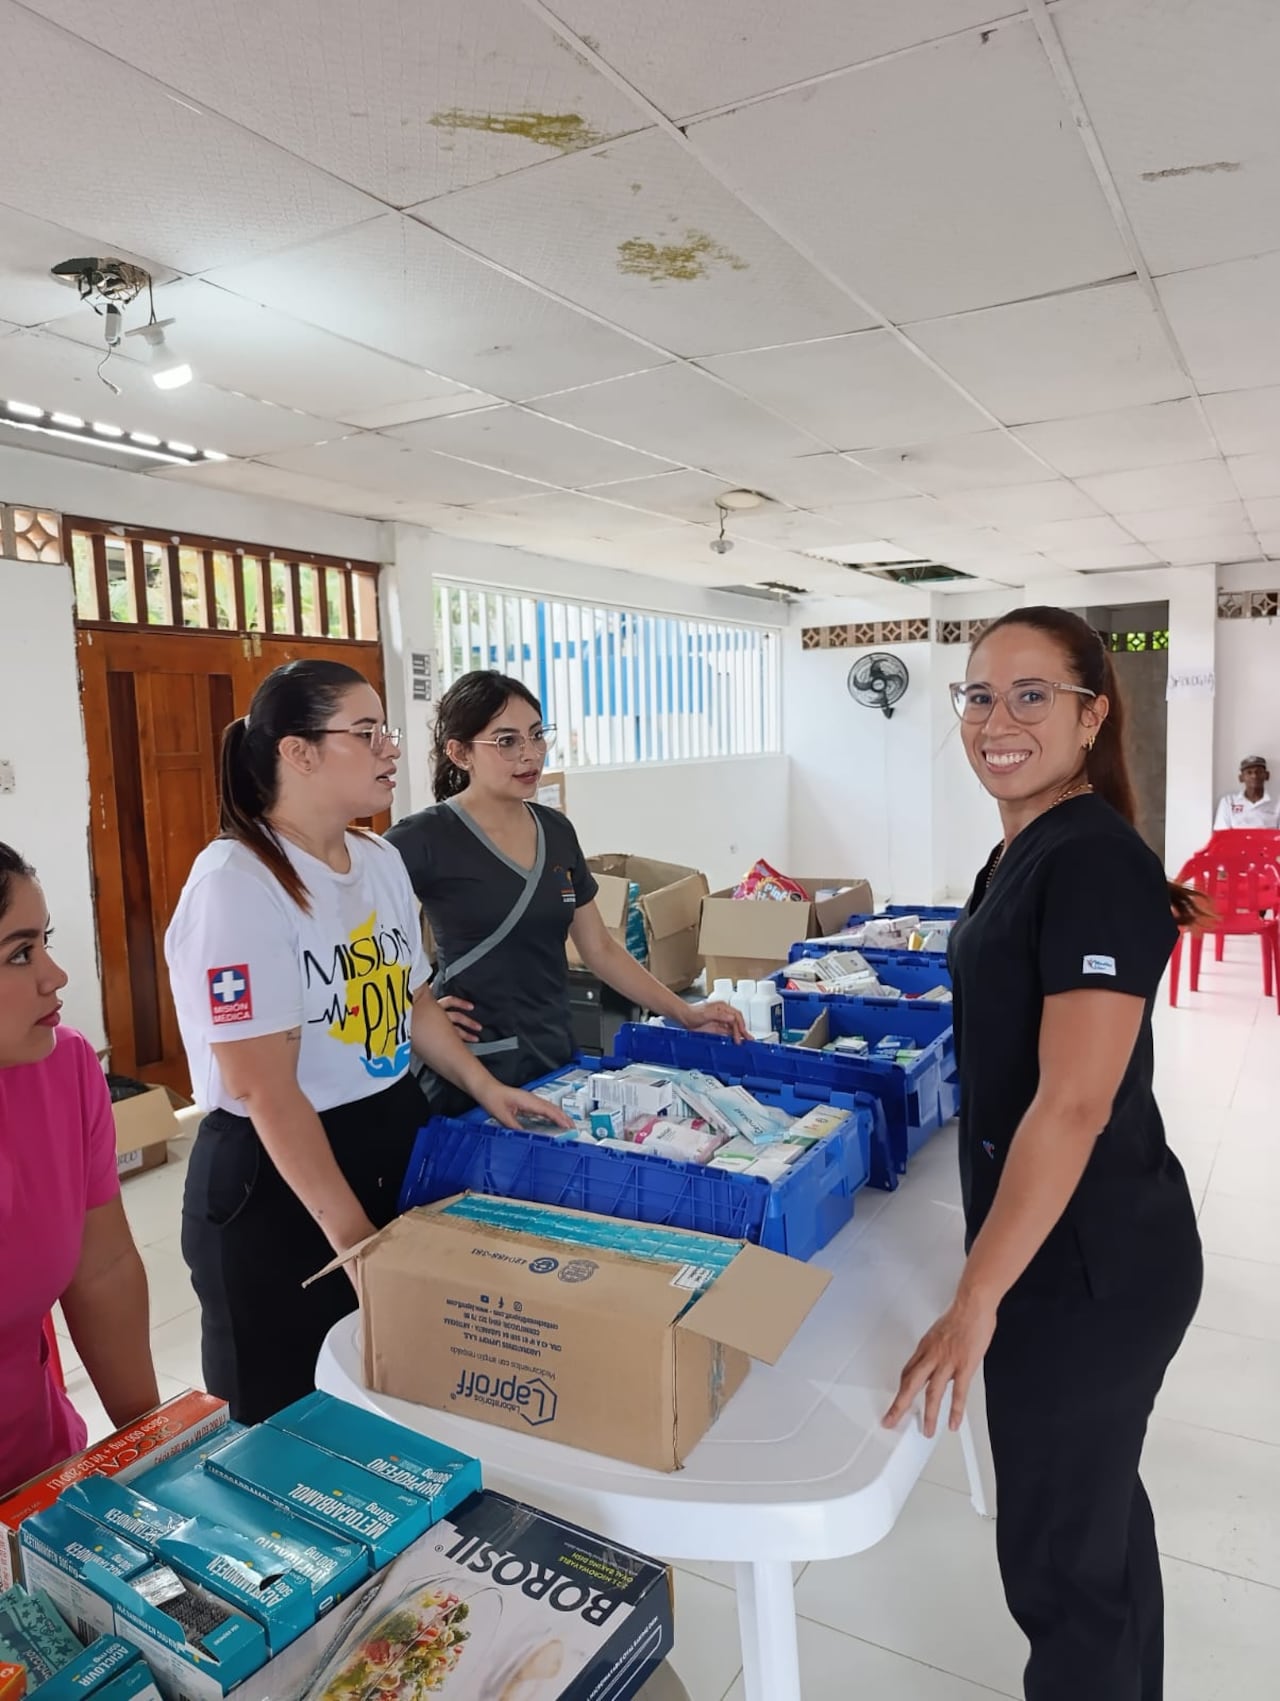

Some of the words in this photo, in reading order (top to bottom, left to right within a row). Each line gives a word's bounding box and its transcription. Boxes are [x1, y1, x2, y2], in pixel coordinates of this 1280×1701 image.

[497, 1357, 509, 1366] con
[455, 1370, 543, 1416] Laproff
[473, 1394, 520, 1413] Laboratorios
[140, 1413, 169, 1433] Calcio
[366, 1456, 443, 1498] IBUPROFENO
[288, 1483, 389, 1541] METOCARBAMOL
[316, 1554, 338, 1572] 500
[557, 1553, 612, 1584] MICROWAVABLE
[570, 1550, 590, 1564] DISH
[586, 1557, 615, 1577] BAKING
[445, 1536, 622, 1627] BOROSIL
[77, 1645, 128, 1686] ACICLOVIR
